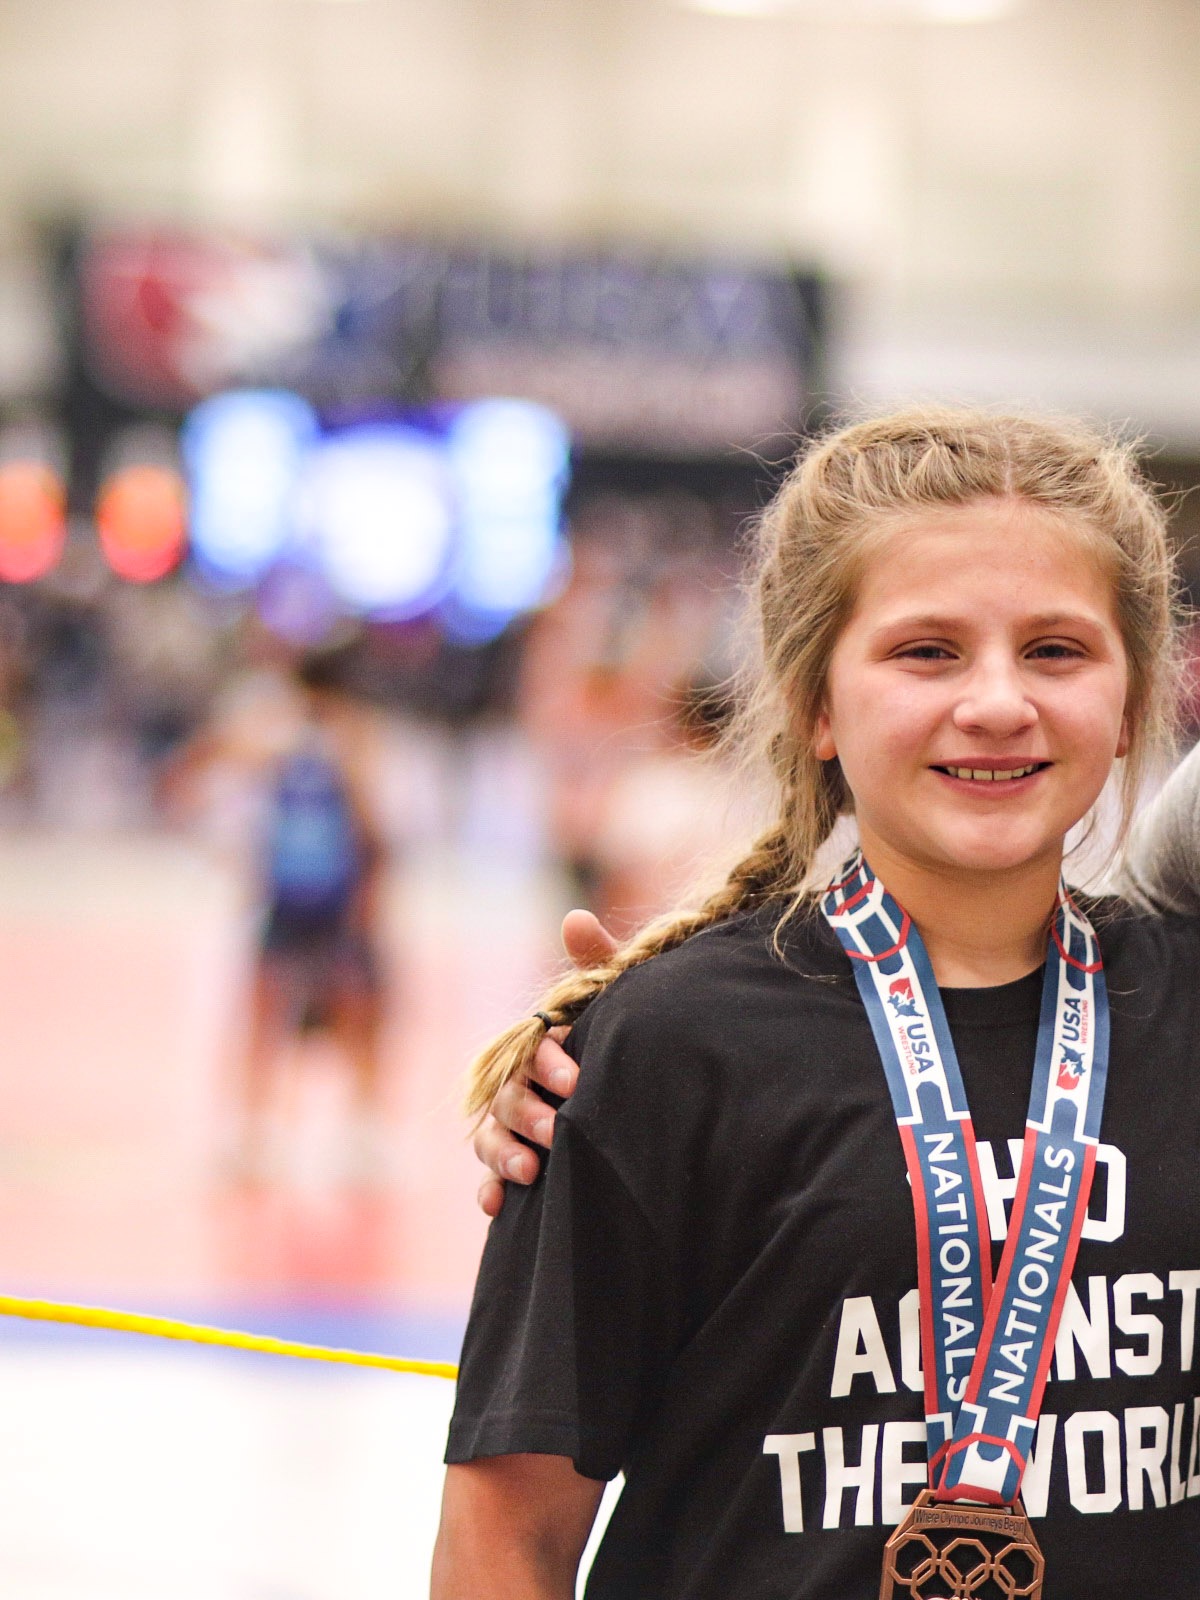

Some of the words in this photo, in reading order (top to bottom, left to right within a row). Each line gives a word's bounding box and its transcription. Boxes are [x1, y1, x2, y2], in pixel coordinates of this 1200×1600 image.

[1062, 997, 1081, 1042] USA
[1080, 1000, 1089, 1044] WRESTLING
[897, 1026, 917, 1076] WRESTLING
[906, 1023, 934, 1074] USA
[923, 1132, 976, 1402] NATIONALS
[988, 1145, 1075, 1404] NATIONALS
[762, 1421, 927, 1533] THE
[915, 1510, 939, 1523] Where
[941, 1511, 970, 1526] Olympic
[970, 1514, 1002, 1529] Journeys
[1002, 1517, 1025, 1535] Begin
